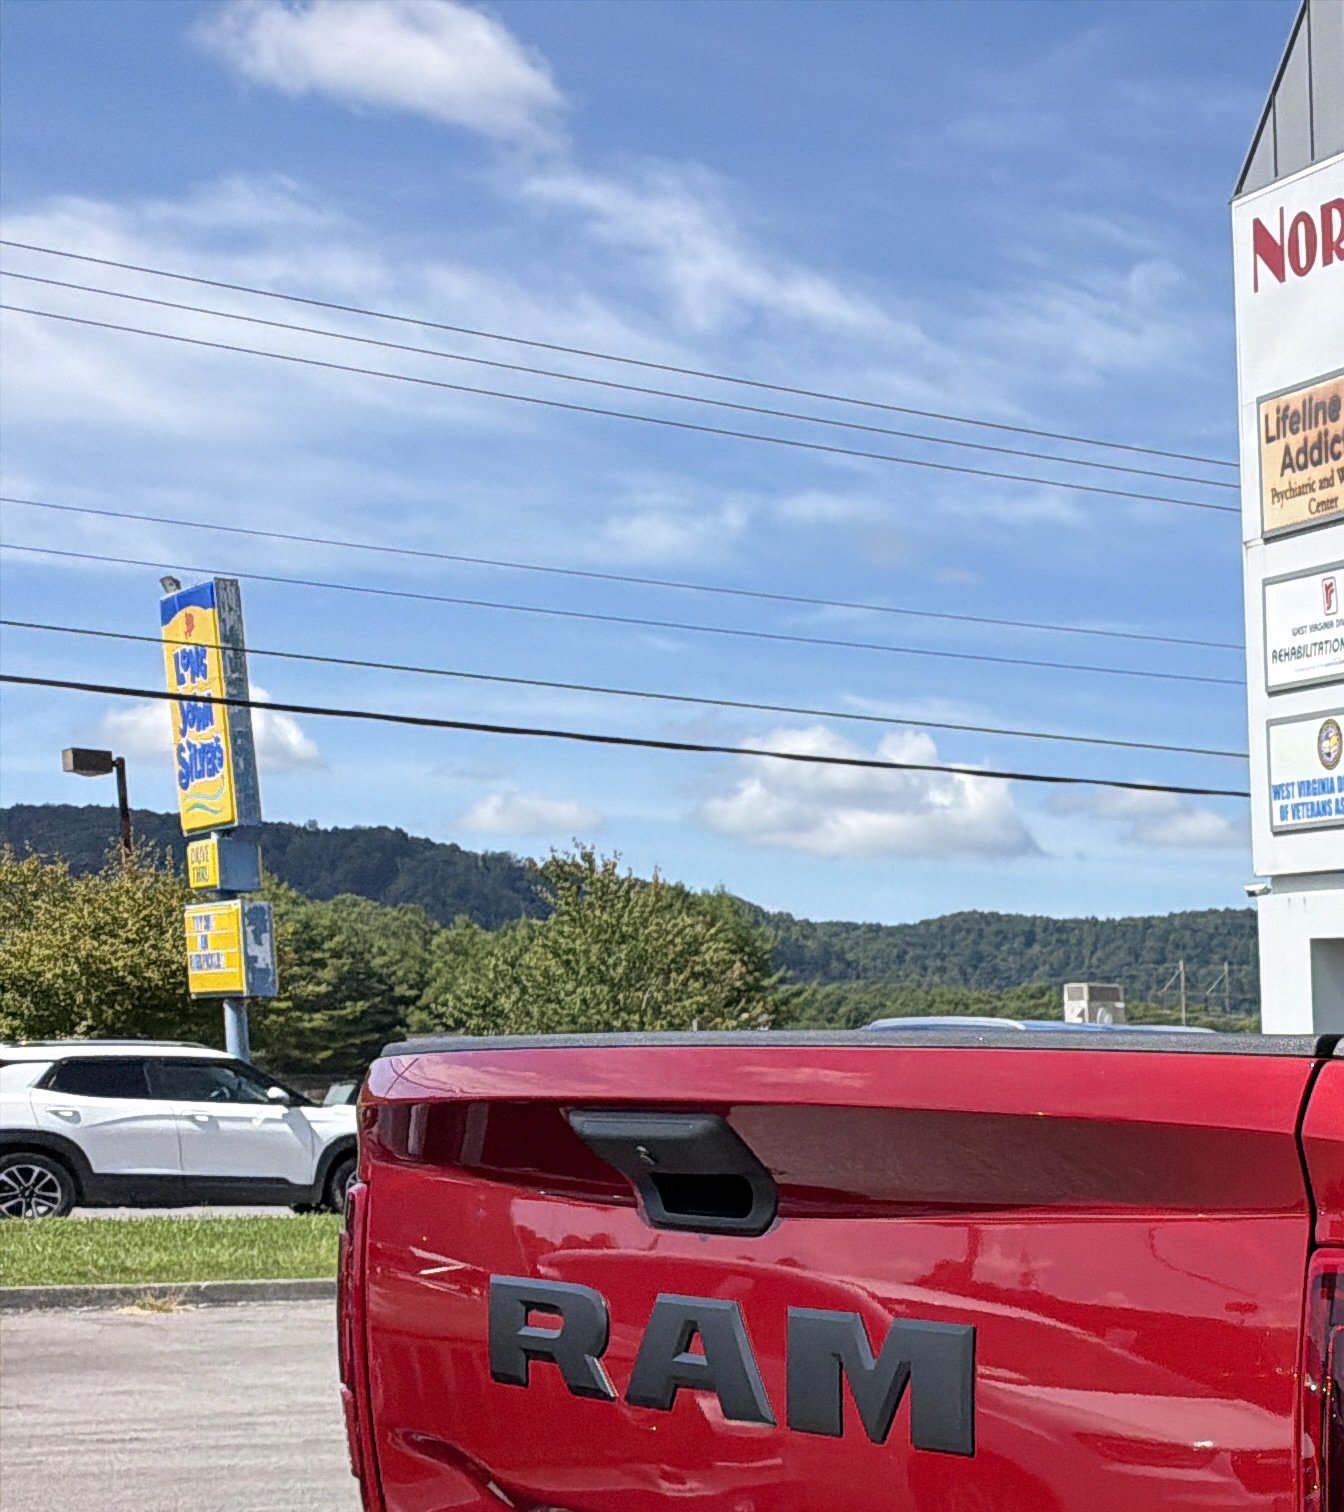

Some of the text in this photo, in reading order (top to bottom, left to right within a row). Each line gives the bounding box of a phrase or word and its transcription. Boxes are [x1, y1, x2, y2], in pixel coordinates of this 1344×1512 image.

[1265, 394, 1342, 444] Lifeline
[1271, 477, 1316, 508] Psychiatric
[1318, 467, 1335, 491] and
[1308, 496, 1339, 515] Center
[1272, 782, 1296, 802] WEST
[1297, 776, 1336, 798] VIRGINIA
[1279, 803, 1289, 822] OF
[1291, 798, 1332, 821] VETERANS
[489, 1273, 975, 1458] RAM
